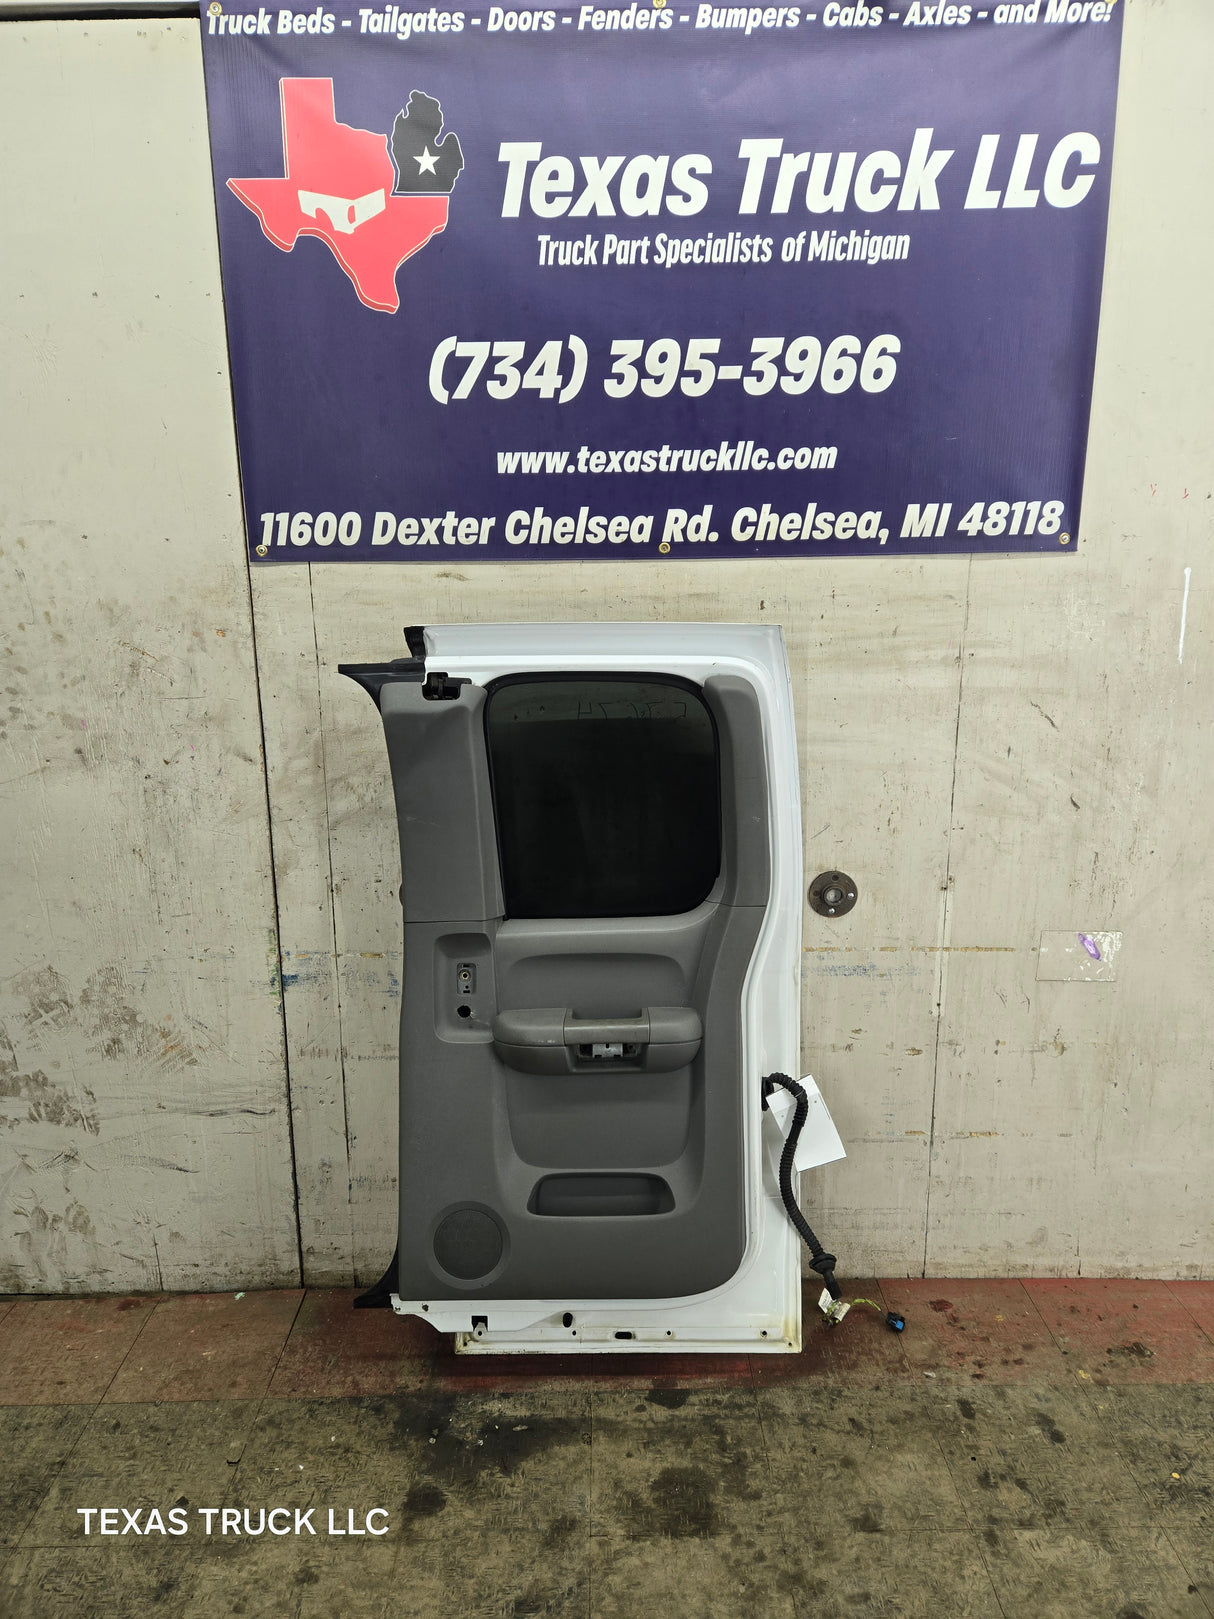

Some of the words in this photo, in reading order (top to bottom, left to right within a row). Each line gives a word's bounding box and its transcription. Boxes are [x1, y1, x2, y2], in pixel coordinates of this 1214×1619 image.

[206, 8, 272, 35] Truck
[276, 6, 336, 35] Beds
[358, 4, 466, 40] Tailgates
[486, 6, 557, 32] Doors
[577, 1, 674, 31] Fenders
[694, 3, 802, 36] Bumpers
[822, 0, 884, 28] Cabs
[902, 0, 973, 26] Axles
[993, 0, 1039, 25] and
[1043, 0, 1115, 23] More!
[497, 141, 712, 218] Texas
[737, 127, 956, 215] Truck
[963, 131, 1101, 210] LLC
[537, 234, 600, 266] Truck
[602, 233, 651, 265] Part
[653, 231, 774, 269] Specialists
[781, 230, 807, 263] of
[807, 229, 911, 265] Michigan
[428, 334, 588, 405] (734)
[603, 333, 901, 399] 395-3966
[497, 440, 838, 474] www.texastruckllc.com
[259, 511, 362, 547] 11600
[371, 511, 496, 546] Dexter
[505, 506, 654, 545] Chelsea
[661, 504, 719, 543] Rd.
[731, 502, 890, 545] Chelsea,
[899, 502, 953, 538] MI
[956, 500, 1065, 536] 48118
